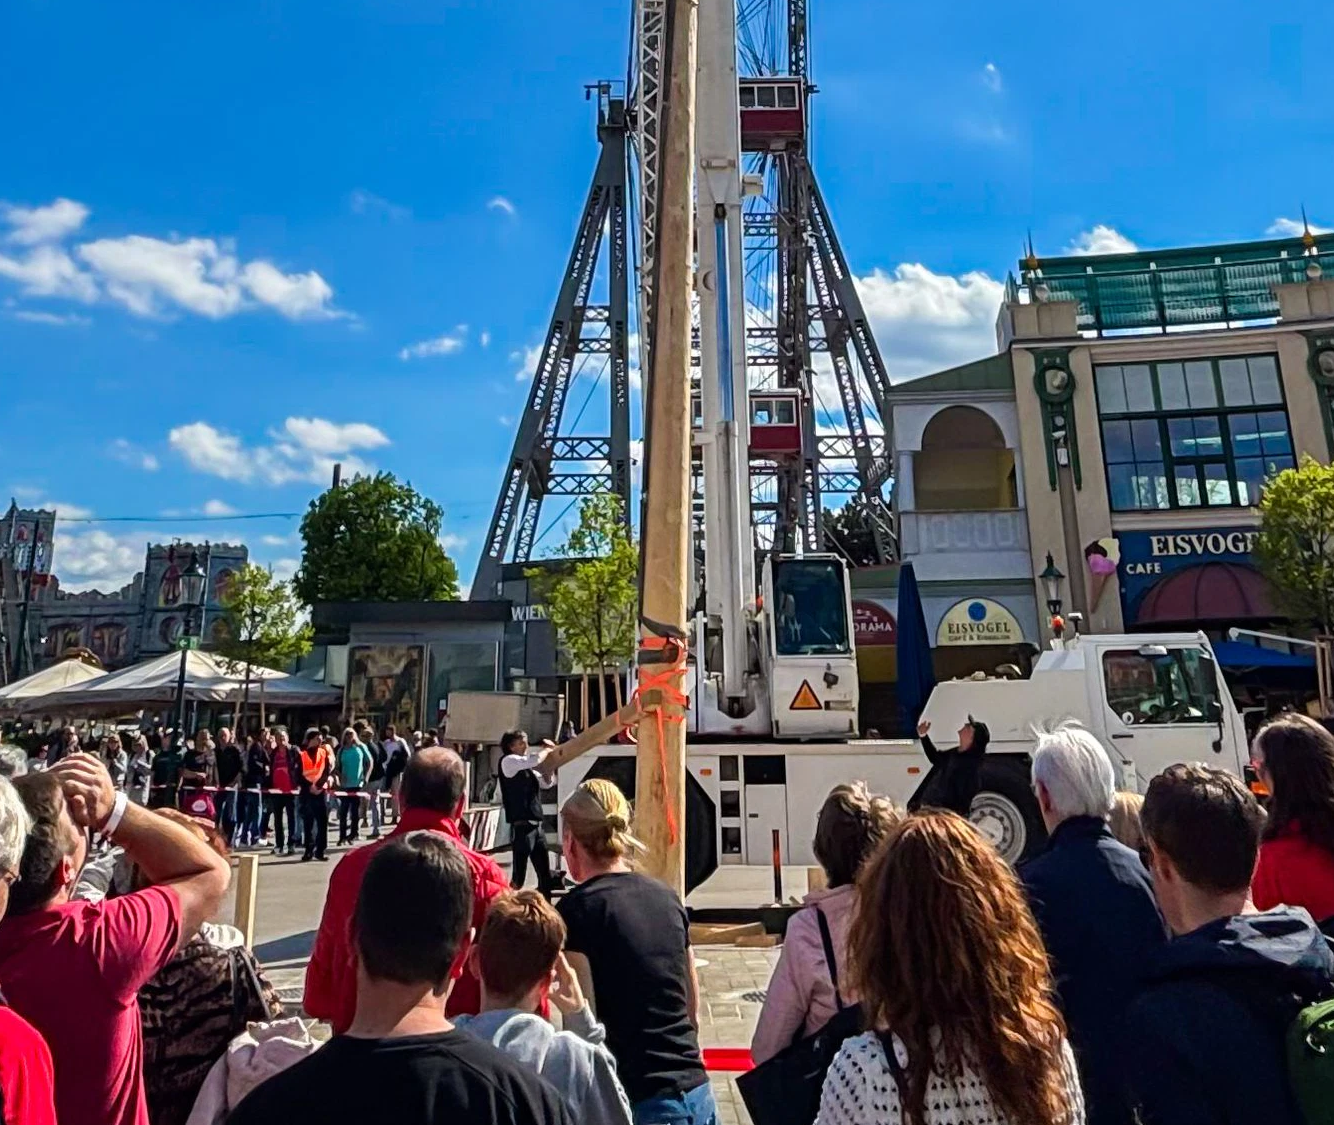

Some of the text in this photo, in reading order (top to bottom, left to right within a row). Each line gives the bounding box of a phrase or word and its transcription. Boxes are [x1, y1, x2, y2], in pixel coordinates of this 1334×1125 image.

[1150, 531, 1266, 556] EISVOGE
[1126, 563, 1162, 574] CAFE
[948, 623, 1011, 634] EISVOGEL
